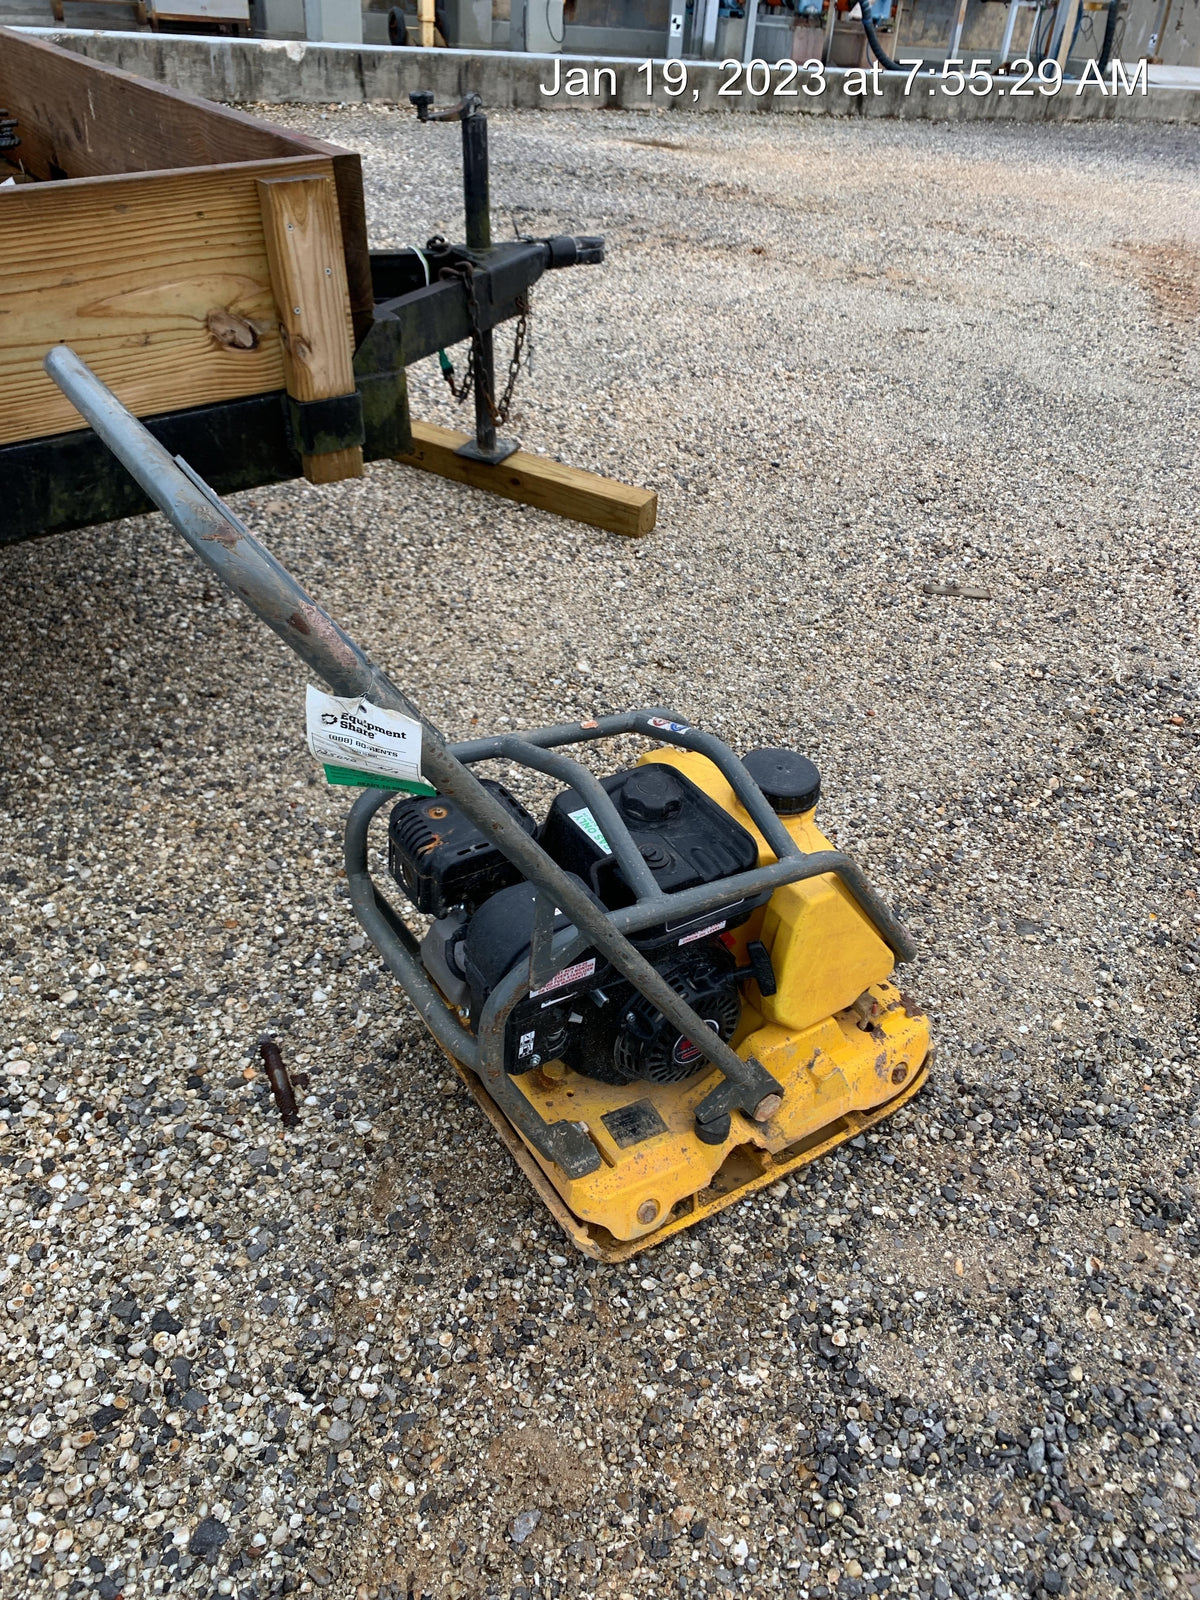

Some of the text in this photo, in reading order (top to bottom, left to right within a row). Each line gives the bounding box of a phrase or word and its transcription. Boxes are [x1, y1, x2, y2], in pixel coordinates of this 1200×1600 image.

[340, 713, 407, 739] Equipment
[340, 721, 375, 739] Share
[573, 815, 597, 833] ONLY
